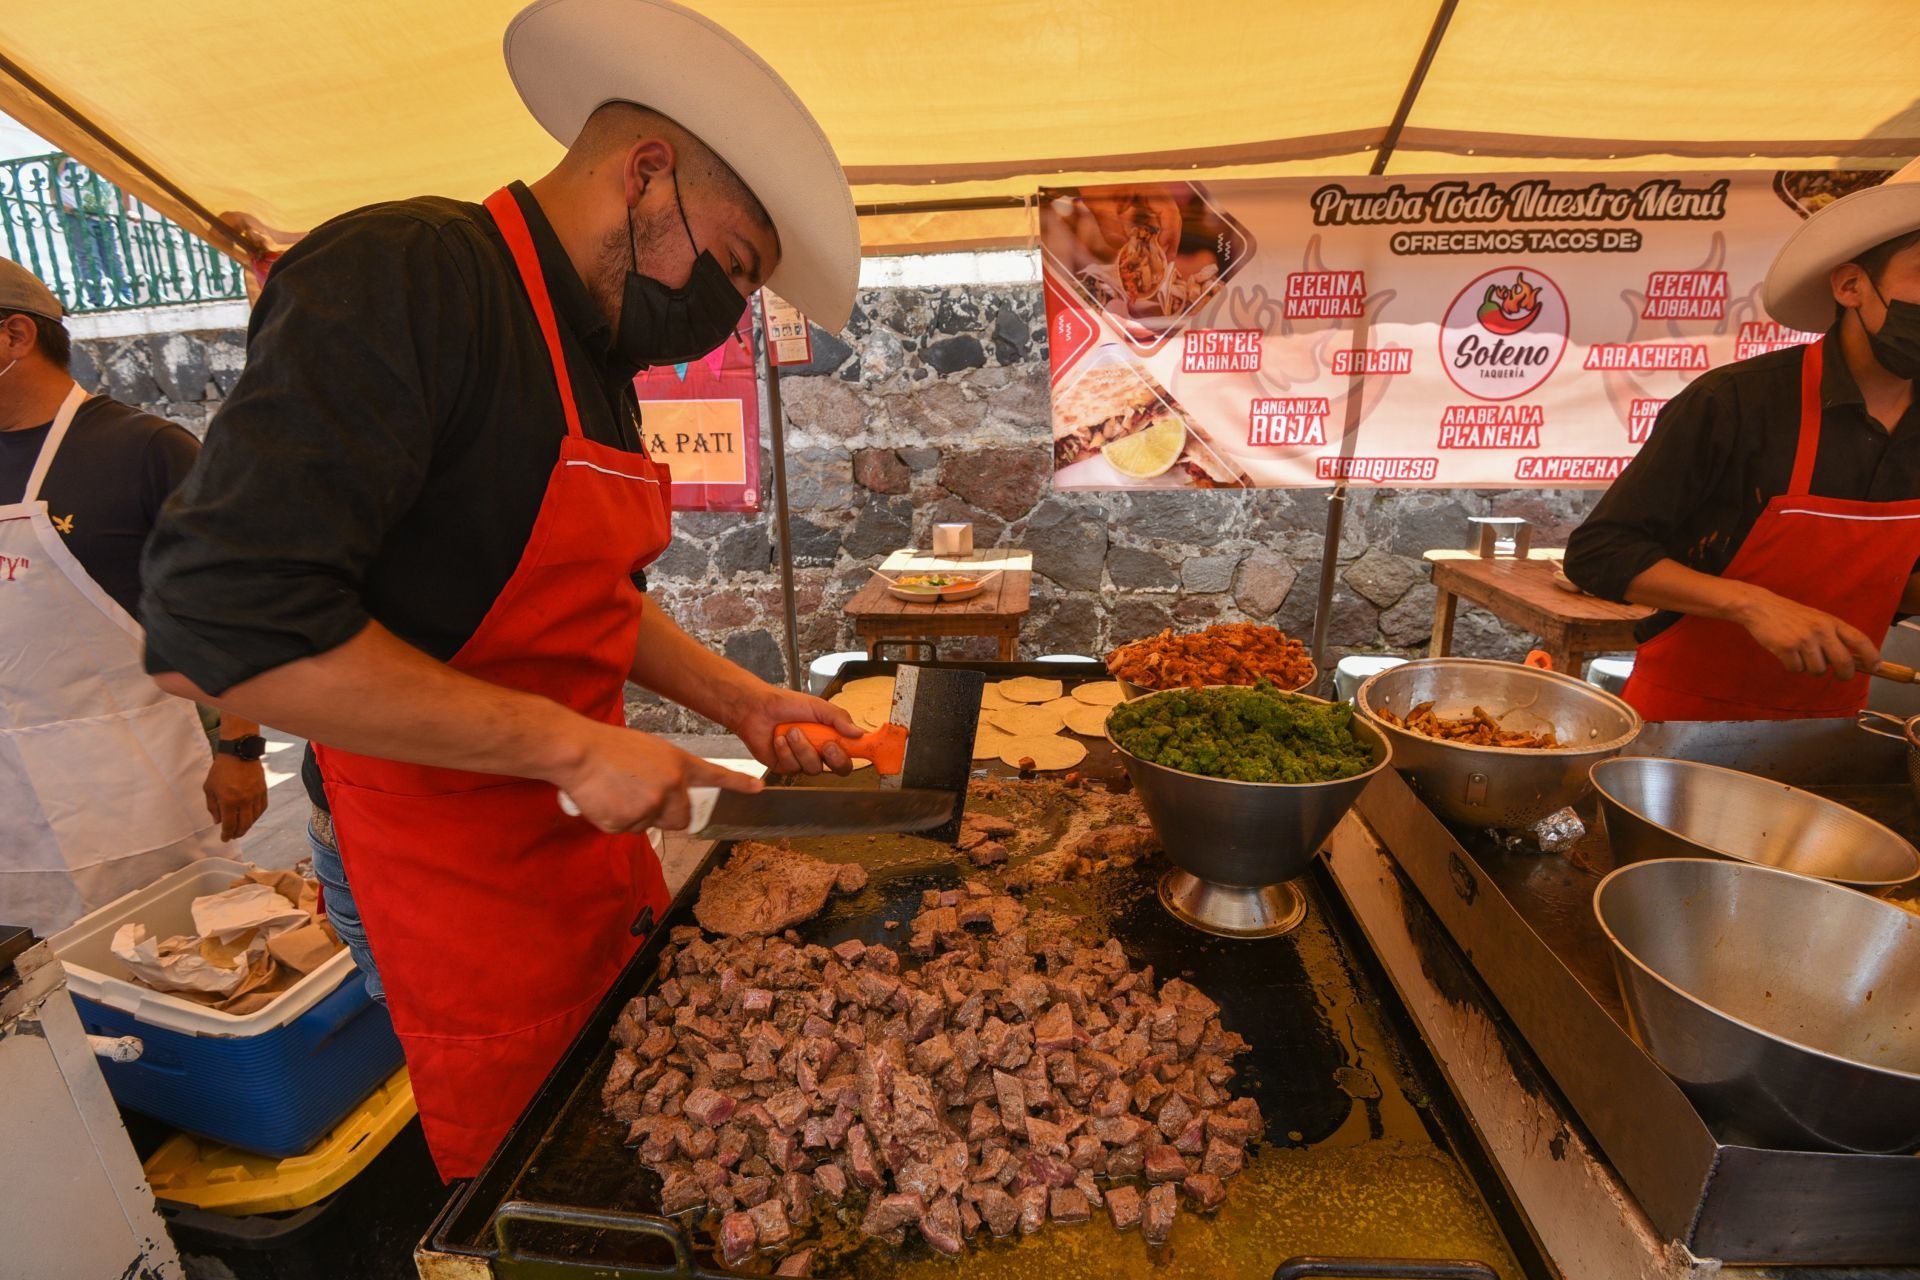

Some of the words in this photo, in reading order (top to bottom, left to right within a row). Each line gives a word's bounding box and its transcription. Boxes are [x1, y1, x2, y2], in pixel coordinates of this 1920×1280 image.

[1314, 186, 1426, 223] Prueba
[1430, 184, 1505, 221] Todo
[1509, 183, 1631, 218] Nuestro
[1633, 182, 1725, 217] Menú
[1393, 233, 1524, 252] OFRECEMOS
[1528, 232, 1598, 250] TACOS
[1603, 232, 1638, 249] DE:
[1288, 273, 1364, 297] CECINA
[1648, 274, 1726, 297] CECINA
[1286, 299, 1362, 317] NATURAL
[1644, 299, 1723, 318] ADOBADA
[1186, 332, 1261, 354] BISTEC
[1453, 334, 1549, 369] Soteno
[1184, 354, 1259, 371] MARINADO
[1334, 351, 1410, 373] SIRLOIN
[1586, 346, 1708, 368] ARRACHERA
[1480, 367, 1525, 379] TAQUERÍA
[1253, 400, 1328, 415] LONGANIZA
[1444, 407, 1497, 425] ARABE
[1503, 407, 1514, 424] A
[1520, 407, 1541, 424] LA
[1250, 415, 1324, 445] ROJA
[1441, 425, 1540, 447] PLANCHA
[675, 432, 734, 453] PATI
[1318, 457, 1437, 482] CHORIQUESO
